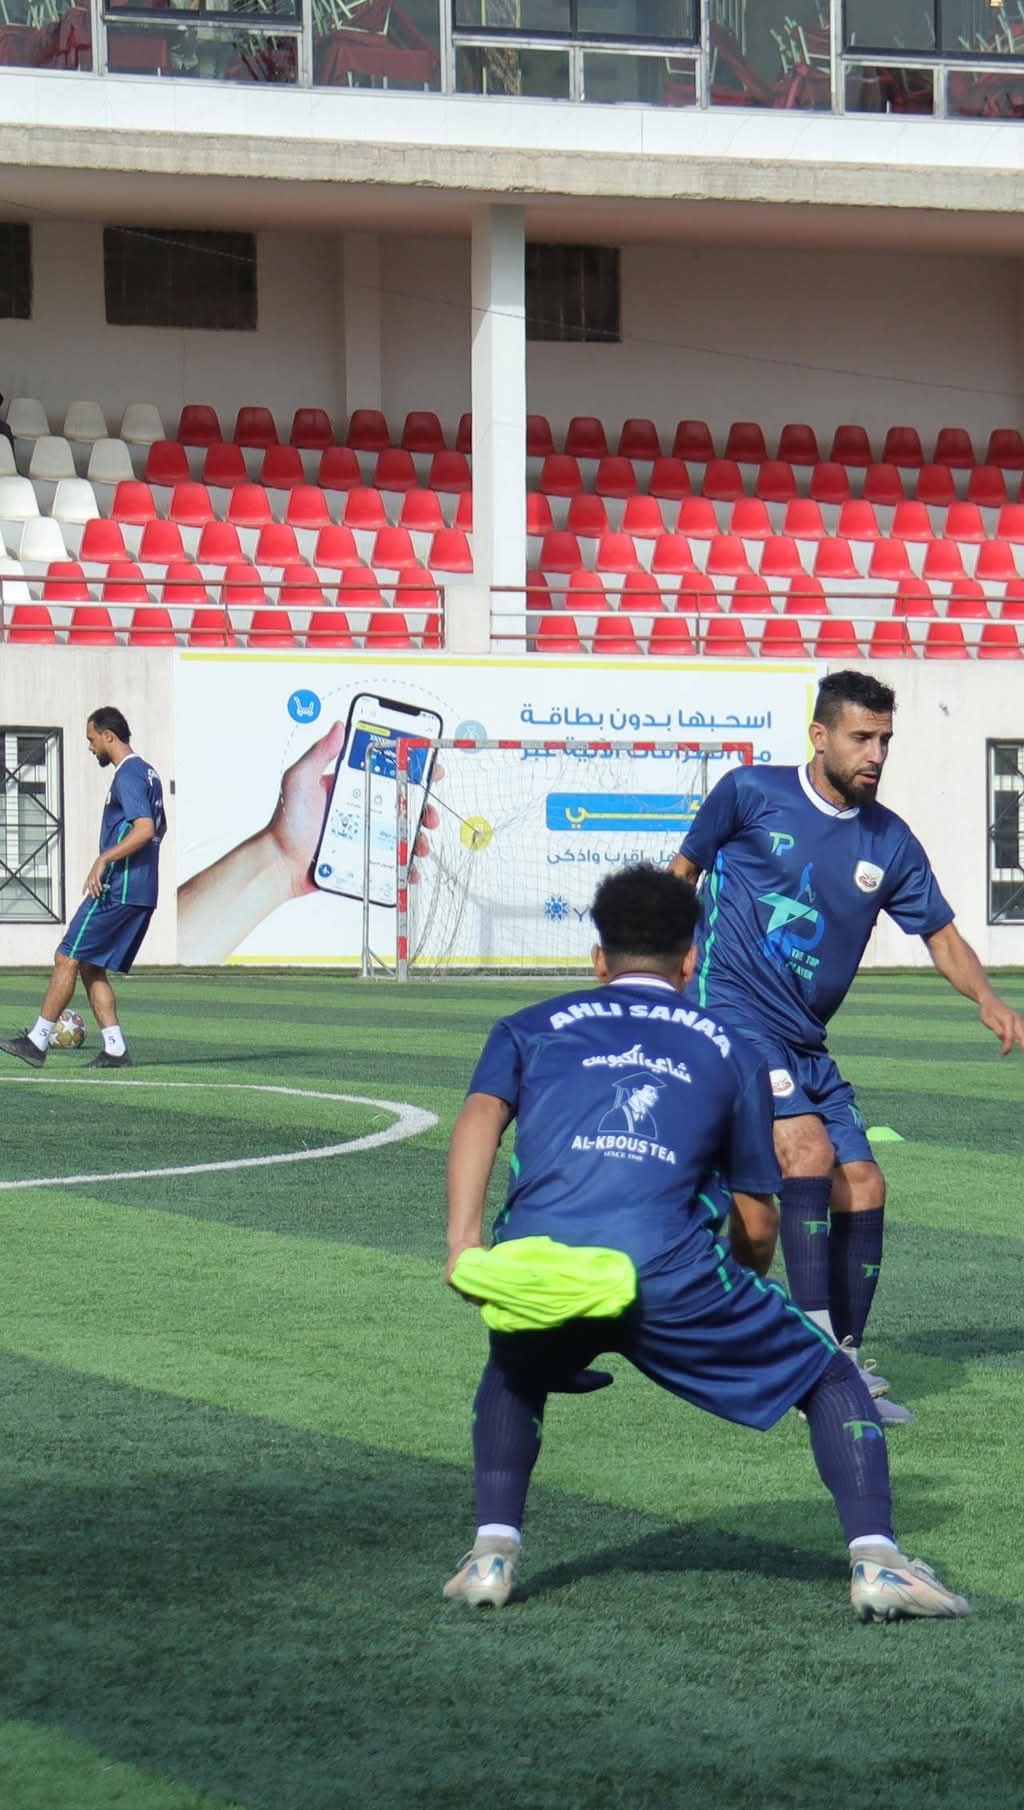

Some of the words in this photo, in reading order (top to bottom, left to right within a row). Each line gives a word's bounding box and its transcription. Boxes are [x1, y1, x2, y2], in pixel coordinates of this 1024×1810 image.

[520, 703, 604, 730] بطاقة
[609, 708, 671, 731] بدون
[677, 709, 772, 732] اسحبها
[550, 1002, 623, 1030] AHLI
[571, 1135, 648, 1154] AL-KBOUS
[649, 1143, 677, 1165] TEA
